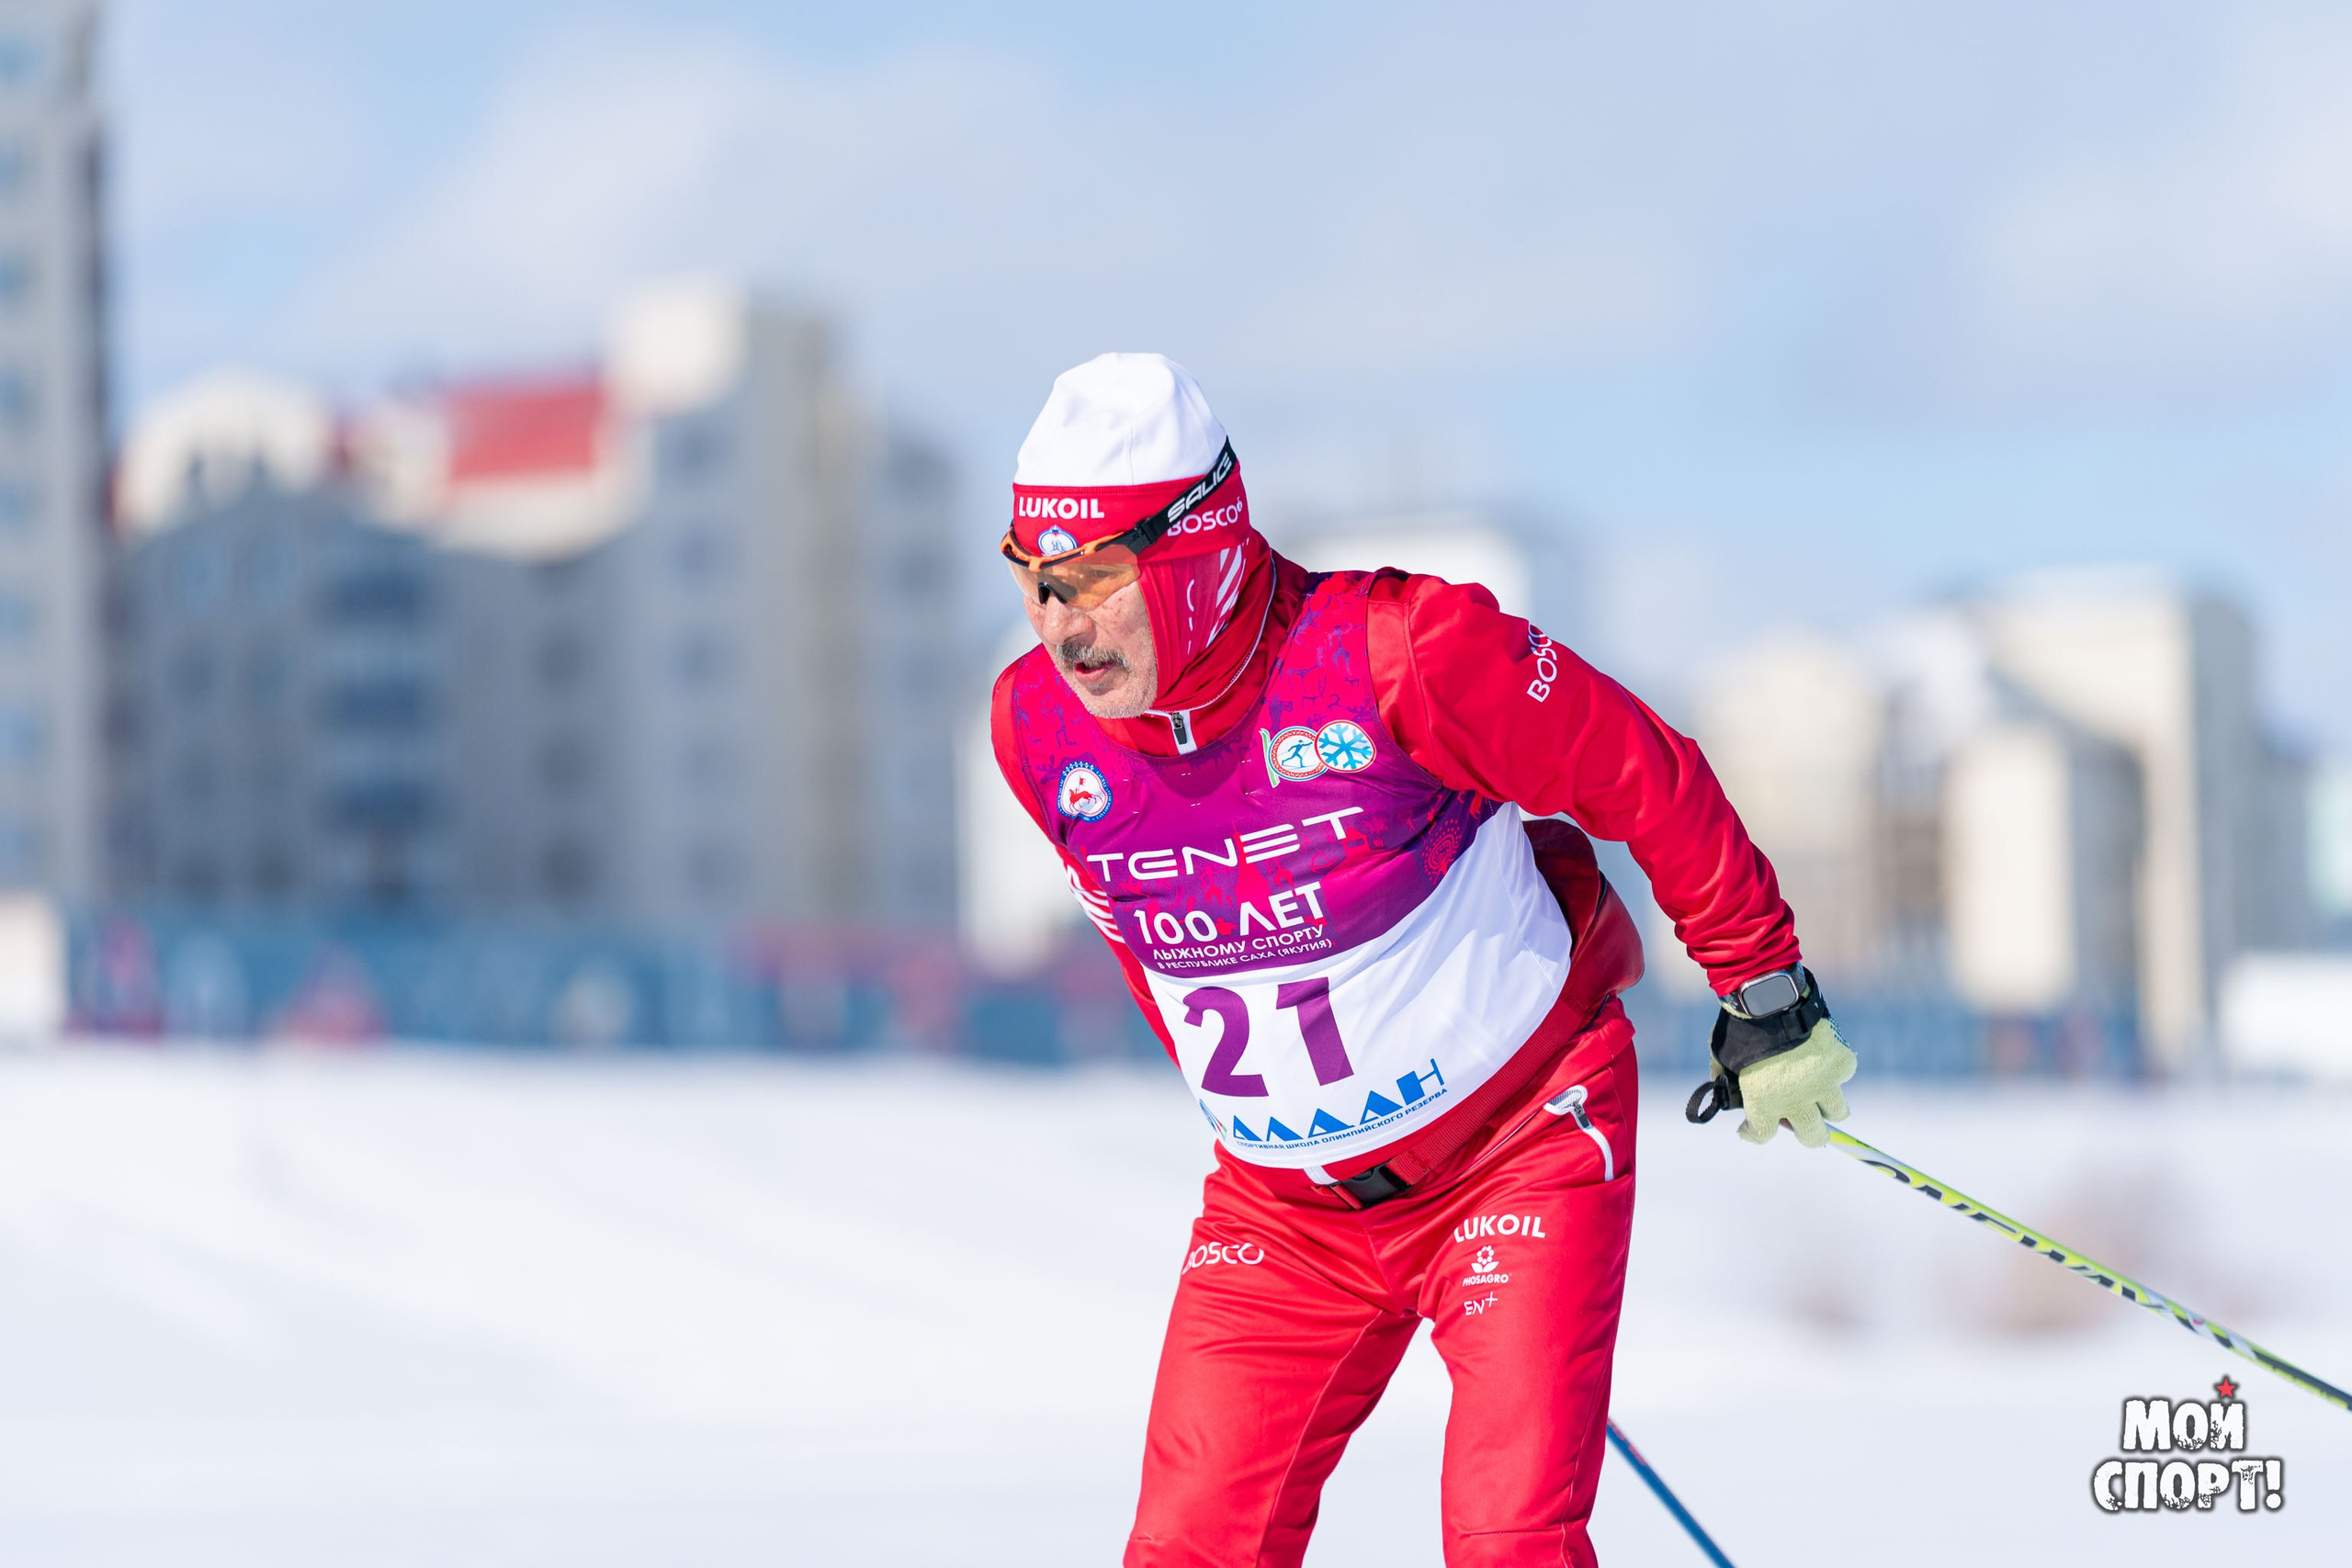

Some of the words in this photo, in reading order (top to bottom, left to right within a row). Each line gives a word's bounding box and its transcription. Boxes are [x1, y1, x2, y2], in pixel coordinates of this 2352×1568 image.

[1018, 496, 1105, 520] LUKOIL
[1168, 452, 1233, 524] SALICE
[1167, 504, 1238, 536] BOSCO
[1086, 806, 1364, 883] TENET
[1133, 908, 1219, 945] 100
[1239, 881, 1325, 937] ЛЕТ
[1152, 941, 1246, 961] ЛЫЖНОМУ
[1251, 923, 1324, 950] СПОРТУ
[1157, 961, 1165, 970] В
[1166, 956, 1238, 970] РЕСПУБЛИКЕ
[1239, 951, 1276, 963] САХА
[1277, 937, 1333, 958] (ЯКУТИЯ)
[1182, 976, 1355, 1098] 21
[1285, 1139, 1320, 1150] ШКОЛА
[1321, 1112, 1404, 1145] ОЛИМПИЙСКОГО
[1405, 1088, 1448, 1115] РЕЗЕРВА
[1453, 1213, 1546, 1244] LUKOIL
